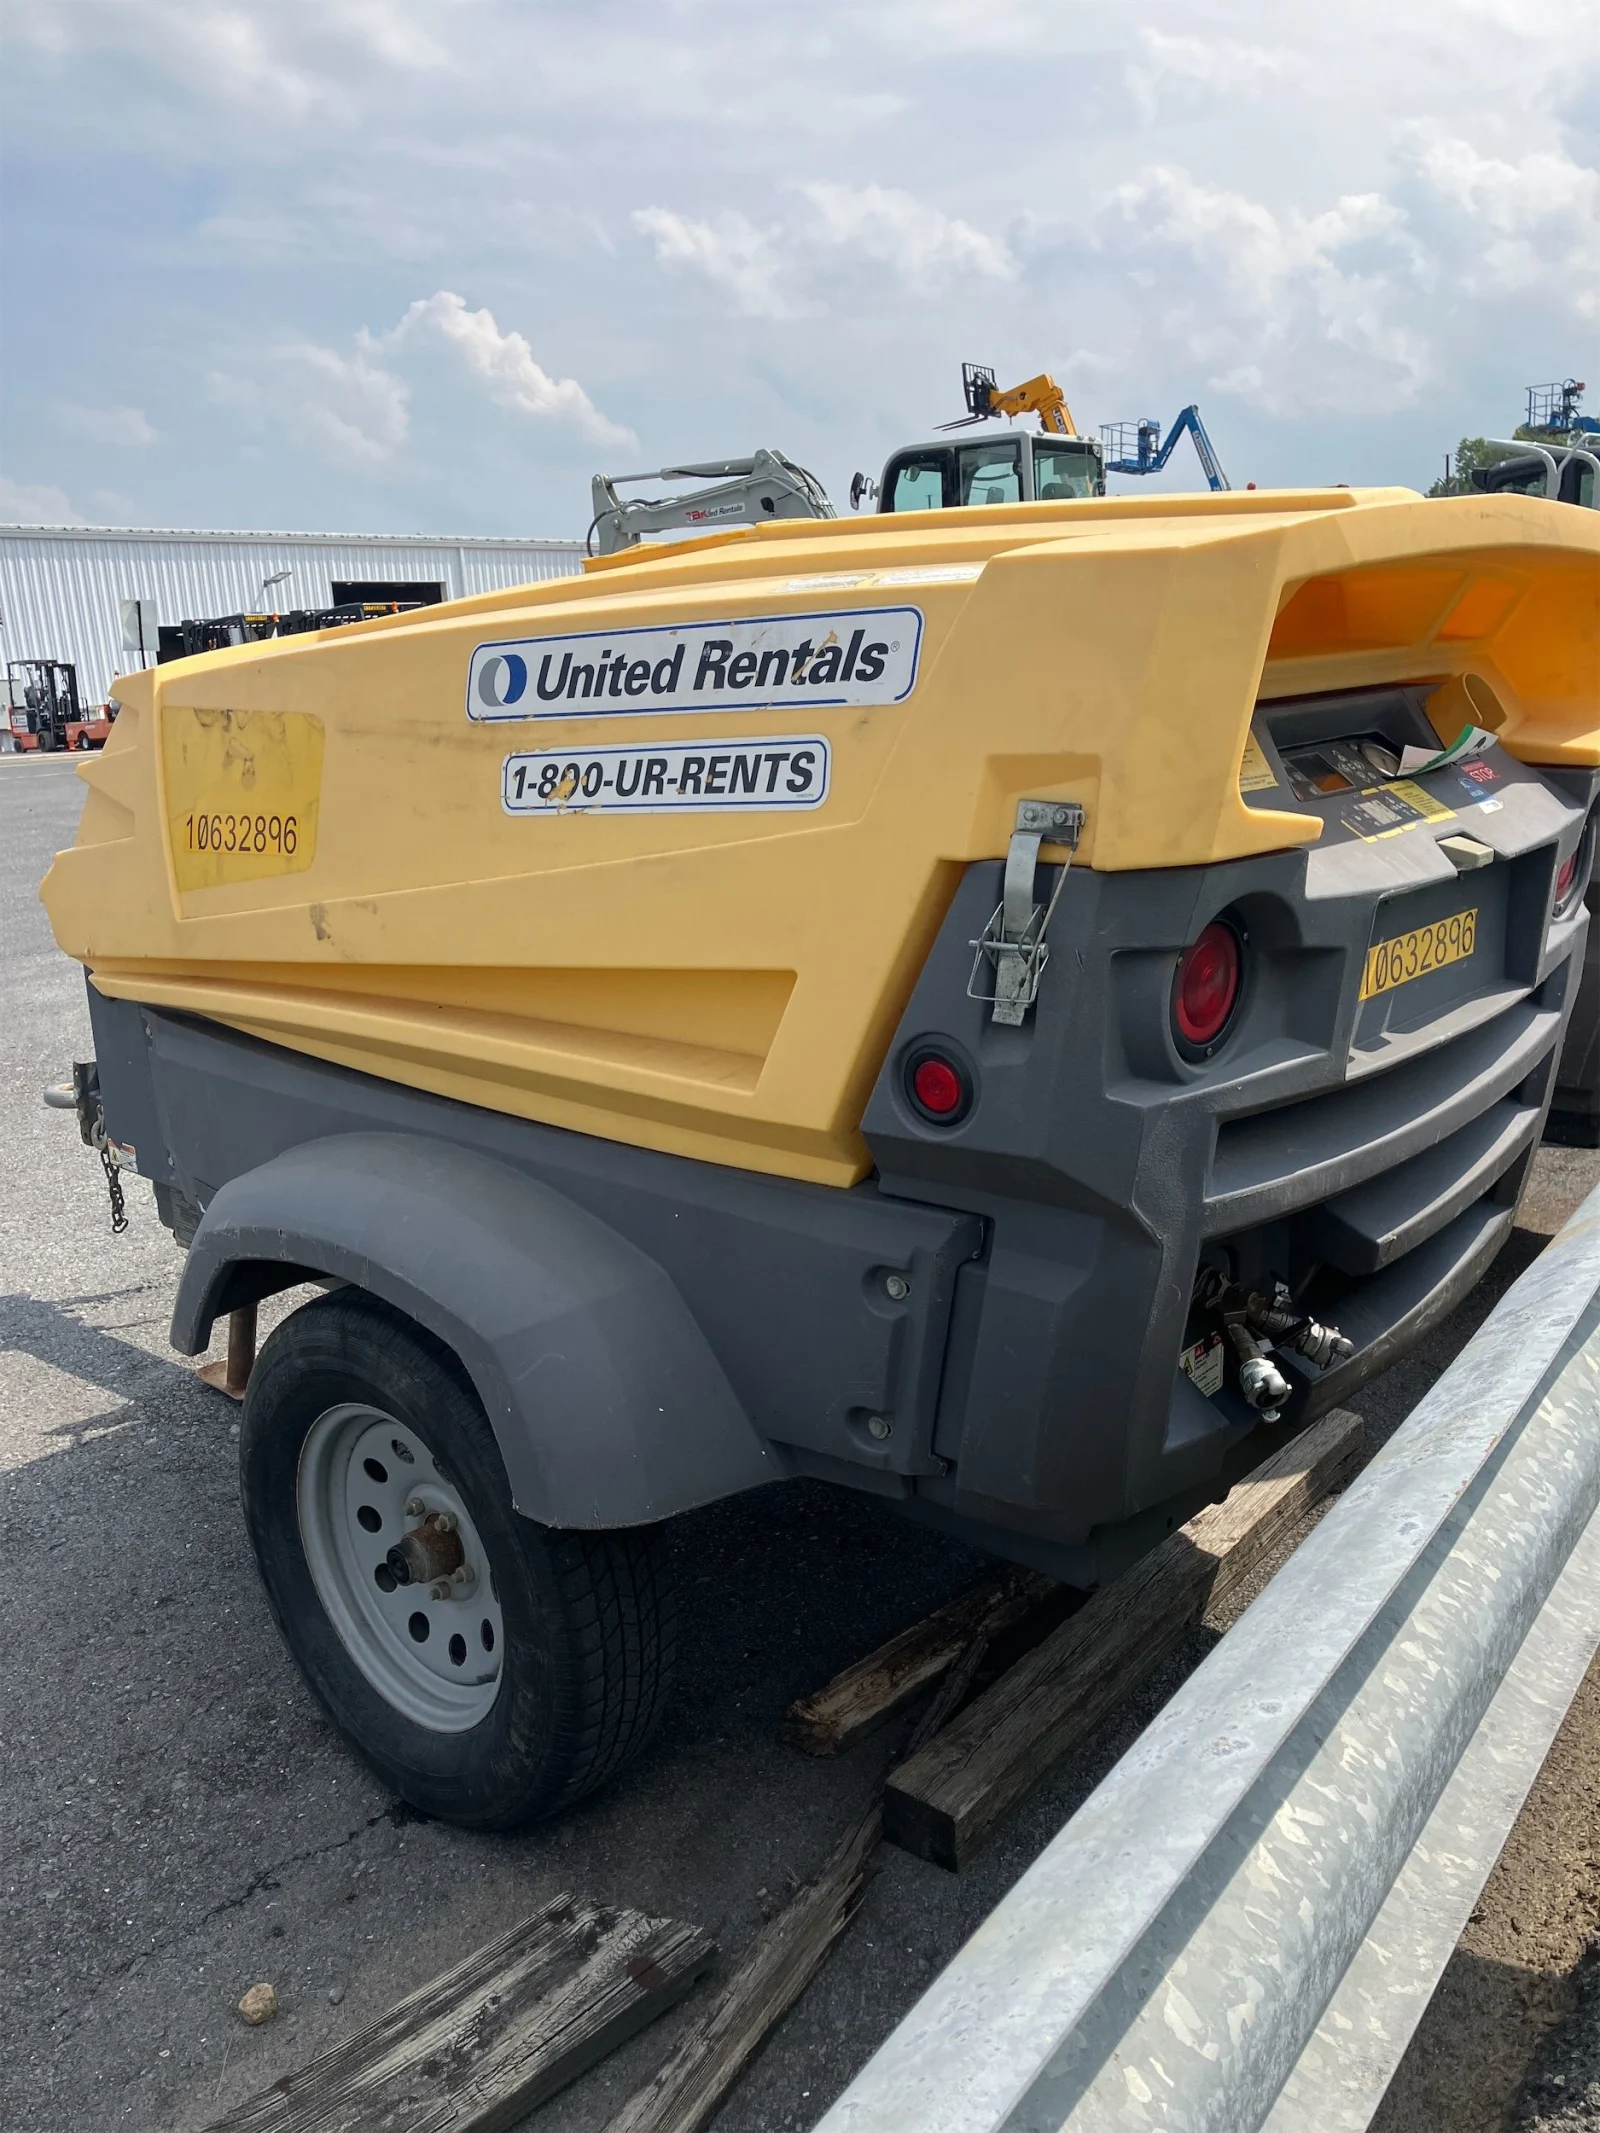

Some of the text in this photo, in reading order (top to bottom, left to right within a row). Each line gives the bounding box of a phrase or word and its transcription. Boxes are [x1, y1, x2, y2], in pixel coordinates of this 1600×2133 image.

[1052, 408, 1067, 434] JCB
[536, 629, 889, 701] United Rentals
[513, 751, 815, 800] 1-800-UR-RENTS
[1469, 767, 1496, 782] STOP
[186, 814, 297, 854] 10632896
[1365, 911, 1474, 995] 10632896
